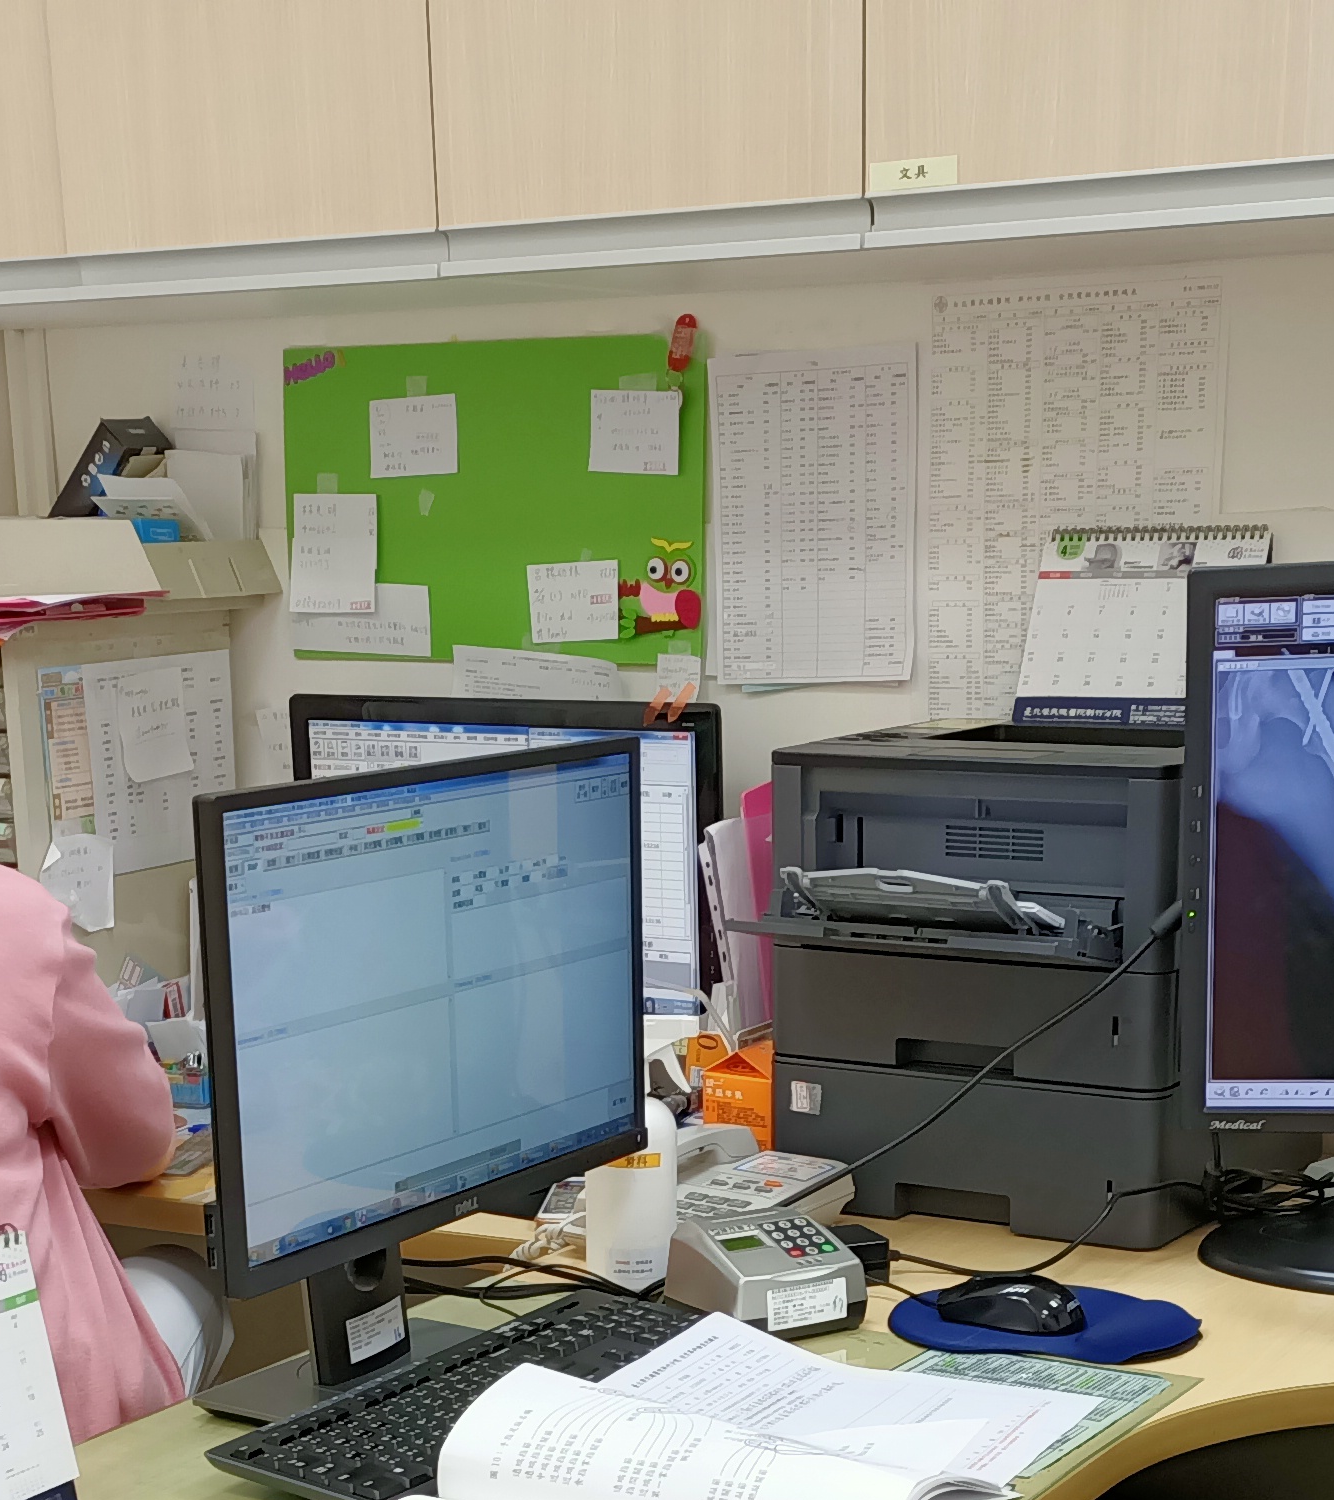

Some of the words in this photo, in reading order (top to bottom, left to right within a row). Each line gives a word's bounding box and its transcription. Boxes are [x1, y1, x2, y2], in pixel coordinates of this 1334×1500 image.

[899, 164, 928, 180] 文具
[1209, 1119, 1267, 1130] Medical
[455, 1196, 479, 1217] DELL
